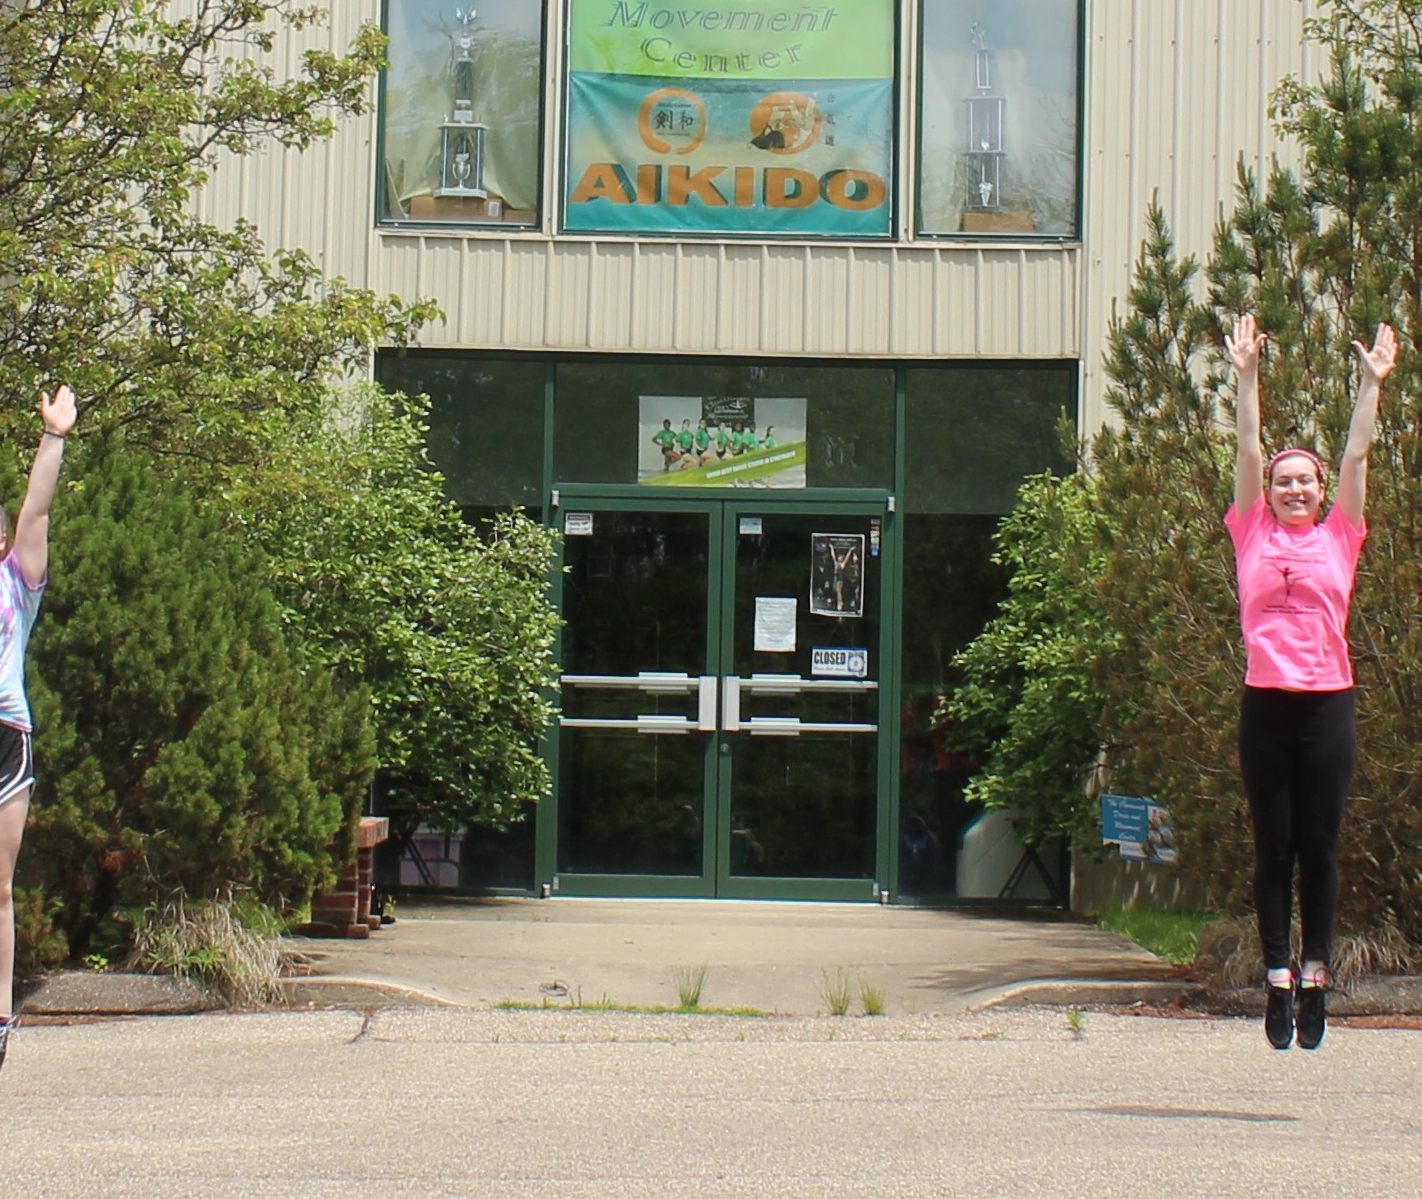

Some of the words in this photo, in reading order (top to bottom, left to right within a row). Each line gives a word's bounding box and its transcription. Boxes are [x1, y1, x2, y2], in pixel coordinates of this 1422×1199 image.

[600, 1, 838, 33] Movement
[640, 37, 803, 73] Center
[568, 163, 887, 211] AIKIDO
[814, 651, 846, 665] CLOSED
